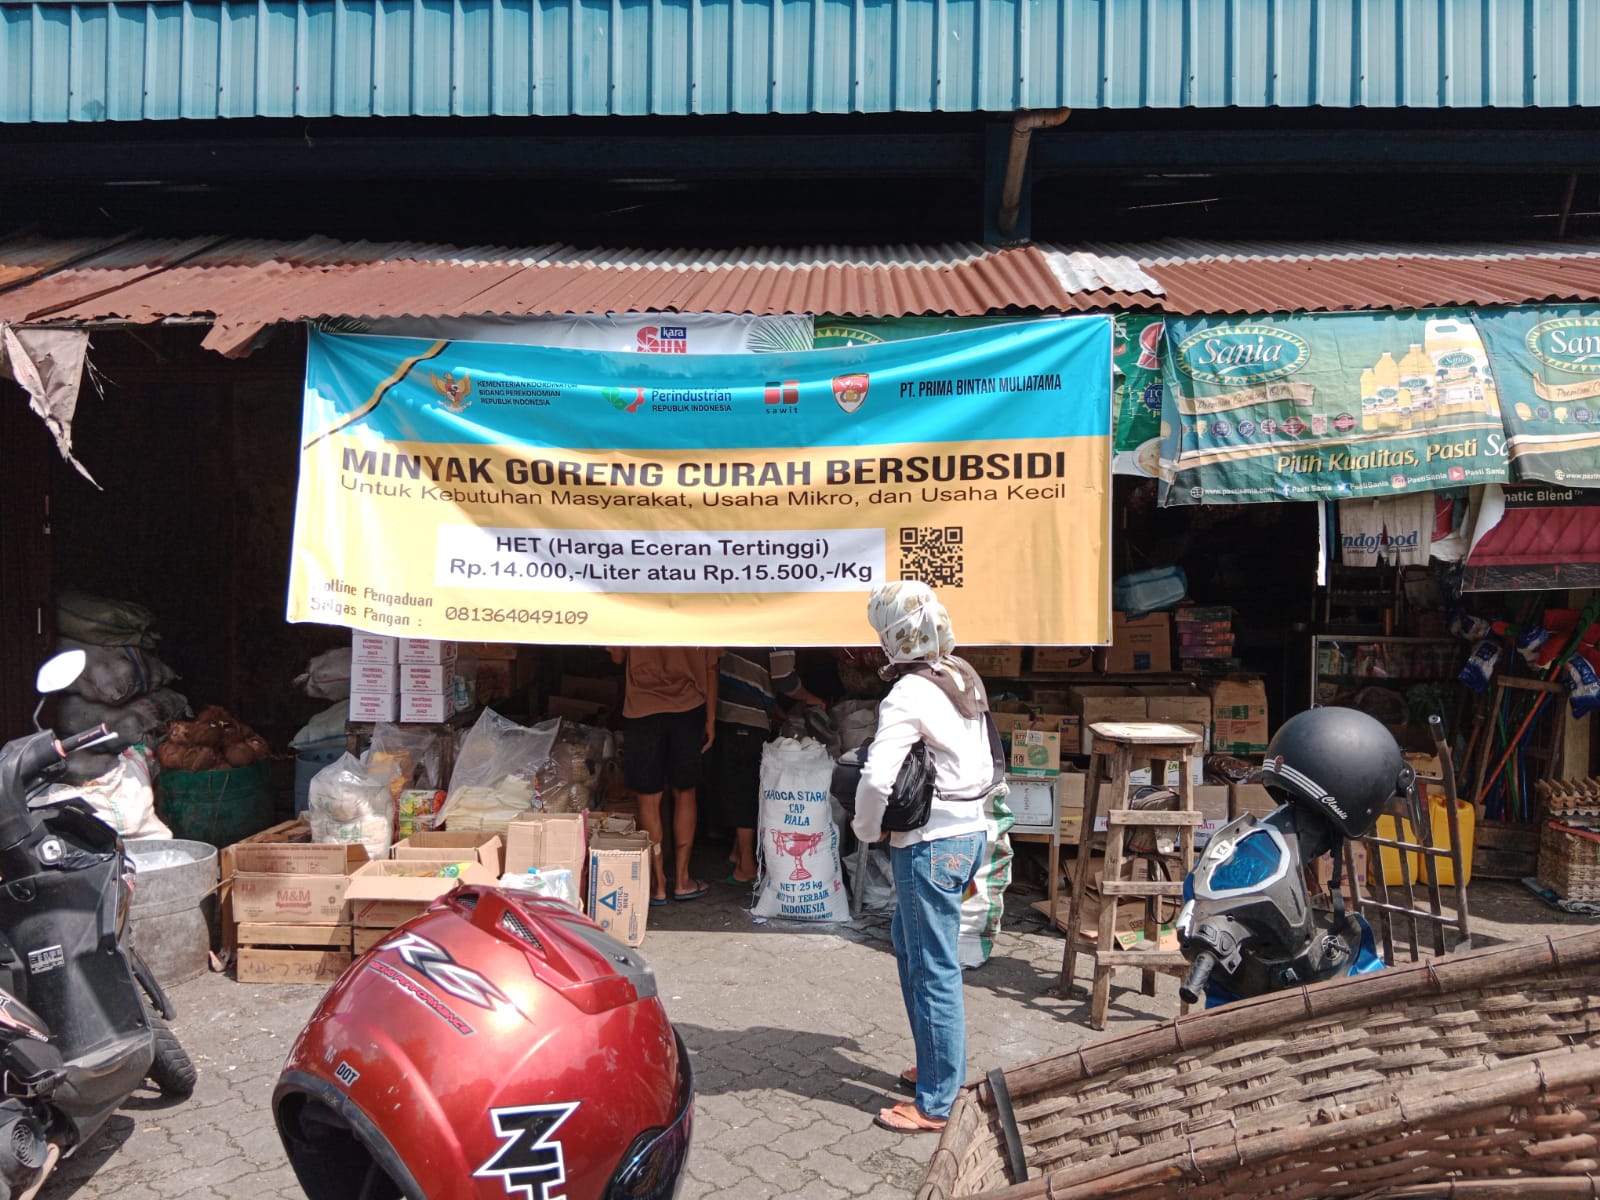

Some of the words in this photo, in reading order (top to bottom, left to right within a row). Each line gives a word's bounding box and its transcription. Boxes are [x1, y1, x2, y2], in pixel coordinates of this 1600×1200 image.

[662, 327, 685, 338] kara
[1551, 330, 1600, 354] San
[1199, 336, 1283, 365] Sania
[651, 389, 732, 402] Perindustrian
[900, 382, 916, 399] PT.
[919, 380, 953, 398] PRIMA
[956, 377, 997, 396] BINTAN
[999, 374, 1062, 393] MULIATAMA
[765, 406, 799, 414] sawit
[1277, 454, 1323, 474] Pilih
[1328, 448, 1420, 473] Kualitas,
[1426, 439, 1479, 462] Pasti
[342, 447, 495, 485] MINYAK
[506, 457, 663, 487] GORENG
[677, 460, 812, 488] CURAH
[827, 452, 1065, 486] BERSUBSIDI
[341, 474, 412, 498] Untuk
[421, 483, 542, 506] Kebutuhan
[551, 490, 693, 510] Masyarakat,
[702, 490, 779, 507] Usaha
[788, 490, 859, 508] Mikro,
[868, 488, 912, 505] dan
[922, 486, 998, 502] Usaha
[1007, 484, 1066, 501] Kecil
[496, 536, 542, 553] HET
[548, 537, 625, 559] (Harga
[631, 539, 712, 557] Eceran
[718, 538, 830, 559] Tertinggi)
[647, 564, 697, 581] atau
[703, 562, 873, 584] Rp.15.500,-/Kg
[364, 587, 433, 608] Pengaduan
[364, 607, 411, 627] Pangan
[445, 606, 590, 625] 081364049109
[788, 803, 805, 814] CAP
[1321, 796, 1348, 820] Classic
[783, 813, 810, 826] PIALA
[276, 889, 311, 902] M&M
[780, 883, 796, 892] NET
[800, 882, 811, 892] 25
[798, 889, 830, 903] TERBAIK
[781, 902, 825, 914] INDONESIA
[336, 1064, 358, 1083] DOT
